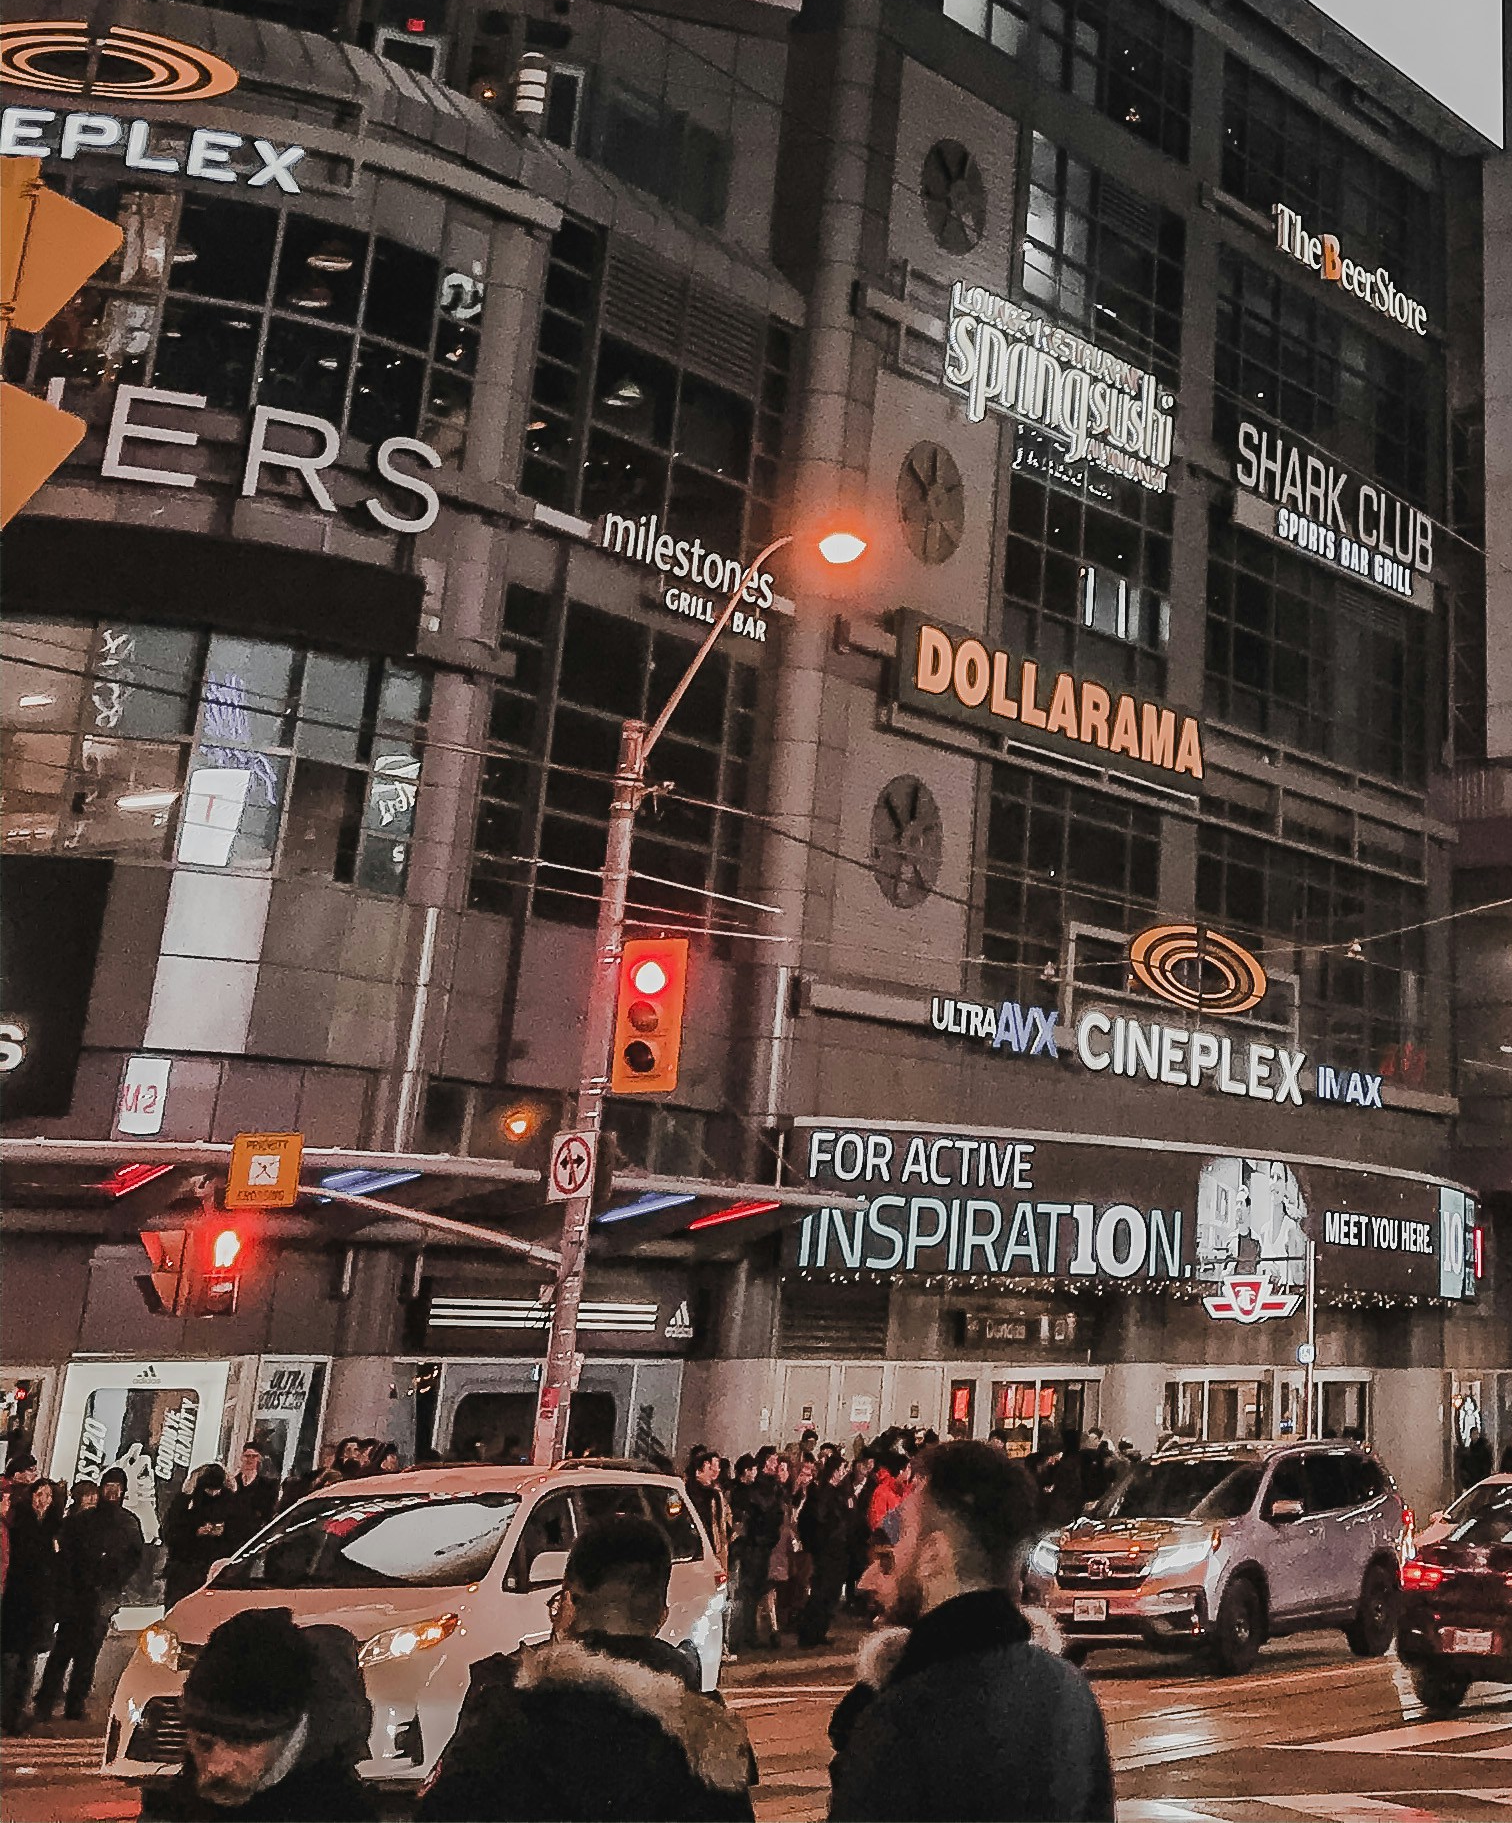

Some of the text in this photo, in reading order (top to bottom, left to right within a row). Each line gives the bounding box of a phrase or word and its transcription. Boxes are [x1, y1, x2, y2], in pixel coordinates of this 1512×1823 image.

[0, 107, 305, 194] EPLEX
[46, 377, 443, 534] ERS
[1236, 422, 1433, 574] SHARK CLUB
[602, 512, 774, 609] milestones
[1278, 507, 1413, 596] SPORTS BAR GRILL
[665, 588, 767, 642] GRILL BAR
[917, 624, 1204, 779] DOLLARAMA
[1077, 1011, 1307, 1106] CINEPLEX
[1317, 1065, 1383, 1108] IMAX
[808, 1131, 1035, 1190] FOR ACTIVE
[1325, 1211, 1433, 1254] MEET YOU HERE.
